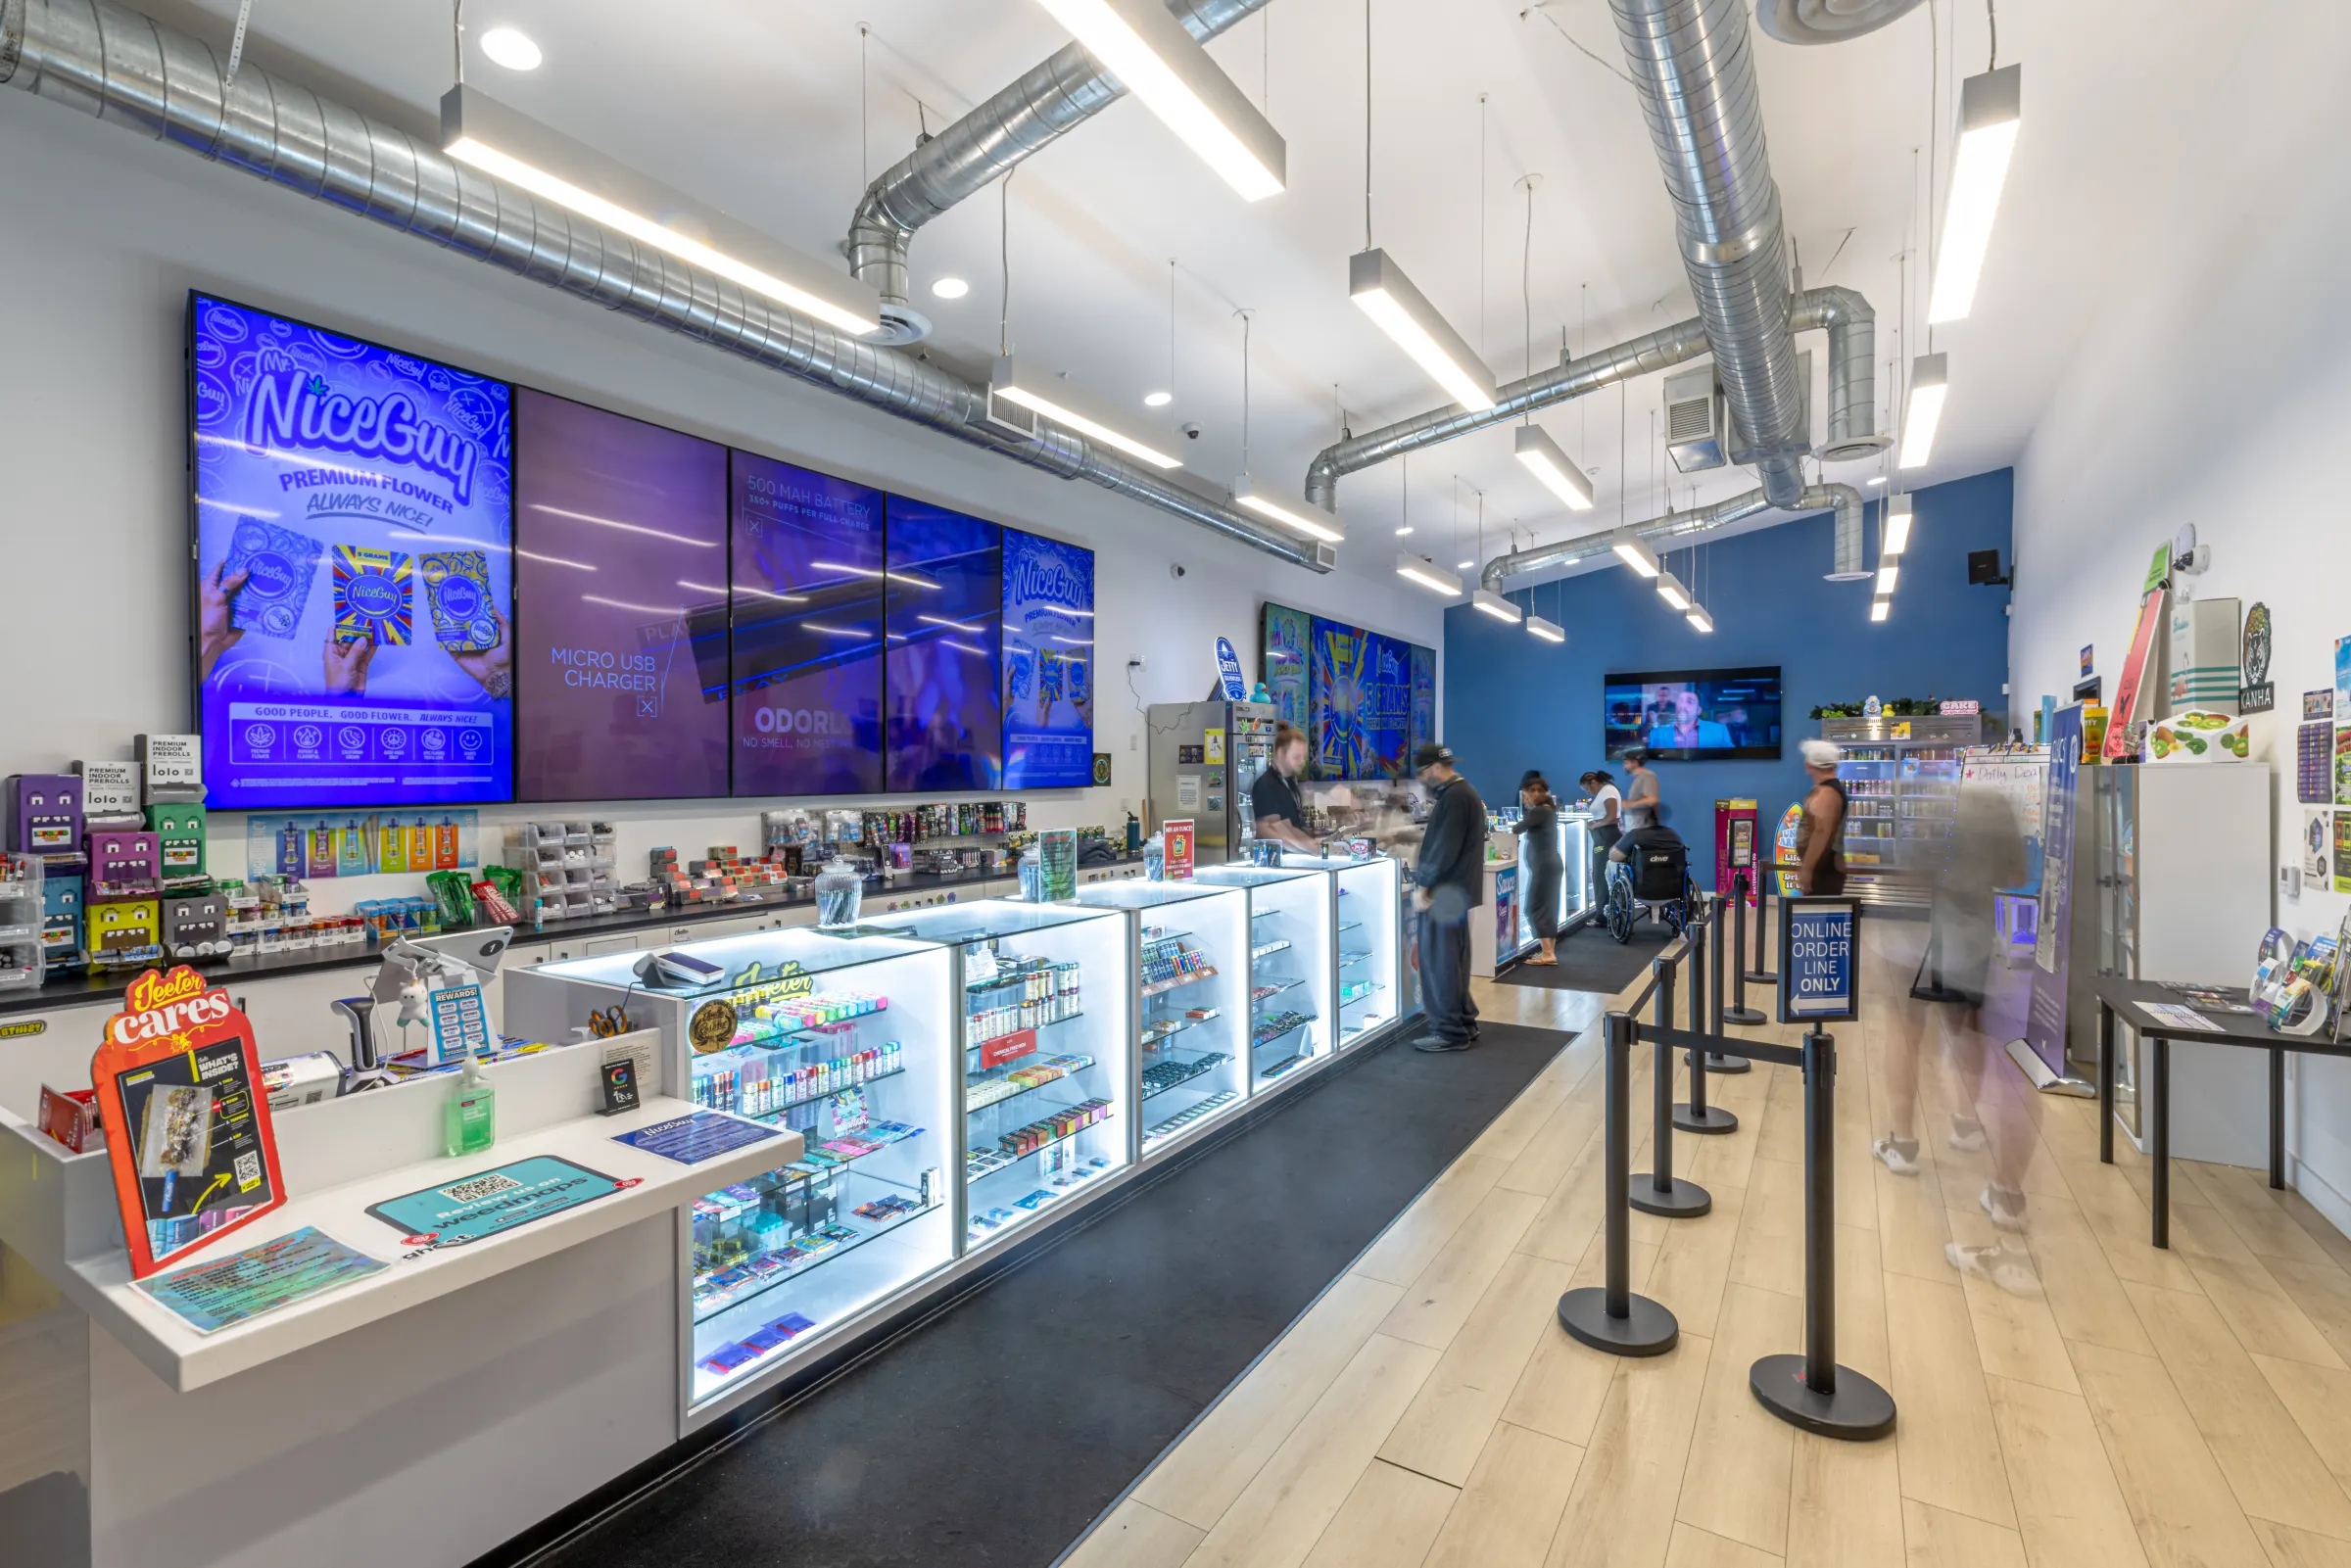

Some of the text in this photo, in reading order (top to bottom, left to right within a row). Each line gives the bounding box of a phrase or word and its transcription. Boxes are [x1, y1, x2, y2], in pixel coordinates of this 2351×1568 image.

[264, 352, 292, 372] Mr.
[386, 354, 425, 381] NiceGuy
[443, 397, 487, 440] NiceGuy
[251, 367, 478, 505] NiceGuy
[279, 468, 385, 493] PREMIUM
[381, 475, 454, 514] FLOWER
[747, 475, 871, 519] 500 MAH BATTERY
[307, 493, 433, 528] ALWAYS NICE!
[773, 500, 798, 514] PUFFS
[801, 507, 817, 518] PER
[819, 509, 838, 523] FULL
[840, 513, 871, 532] CHARGE
[249, 559, 292, 589] NiceGuy
[353, 586, 397, 605] NiceGuy
[1015, 557, 1082, 623] NiceGuy
[552, 647, 655, 672] MICRO USB
[1220, 658, 1239, 672] JETTY
[565, 670, 655, 691] CHARGER
[1375, 684, 1409, 716] GRAMS
[1943, 701, 1977, 710] CAKE
[2240, 687, 2272, 710] KANHA
[255, 707, 478, 724] GOOD PEOPLE. GOOD FLOWER. ALWAYS NICE!
[743, 737, 758, 748] NO
[761, 737, 792, 749] SMELL,
[796, 738, 811, 748] NO
[1979, 766, 2007, 784] Daily
[1497, 874, 1515, 895] Sauce
[1792, 923, 1851, 938] ONLINE
[490, 943, 497, 953] 1
[1793, 941, 1848, 957] ORDER
[1804, 961, 1837, 974] LINE
[735, 961, 812, 997] Jeeter
[1800, 977, 1841, 991] ONLY
[134, 970, 203, 1012] Jeeter
[436, 989, 478, 1002] REWARDS!
[115, 993, 229, 1044] cares
[199, 1053, 238, 1071] WHAT'S
[202, 1061, 239, 1080] INSIDE?
[610, 1068, 628, 1085] G
[431, 1175, 589, 1229] weedmaps
[436, 1177, 561, 1218] Review us on
